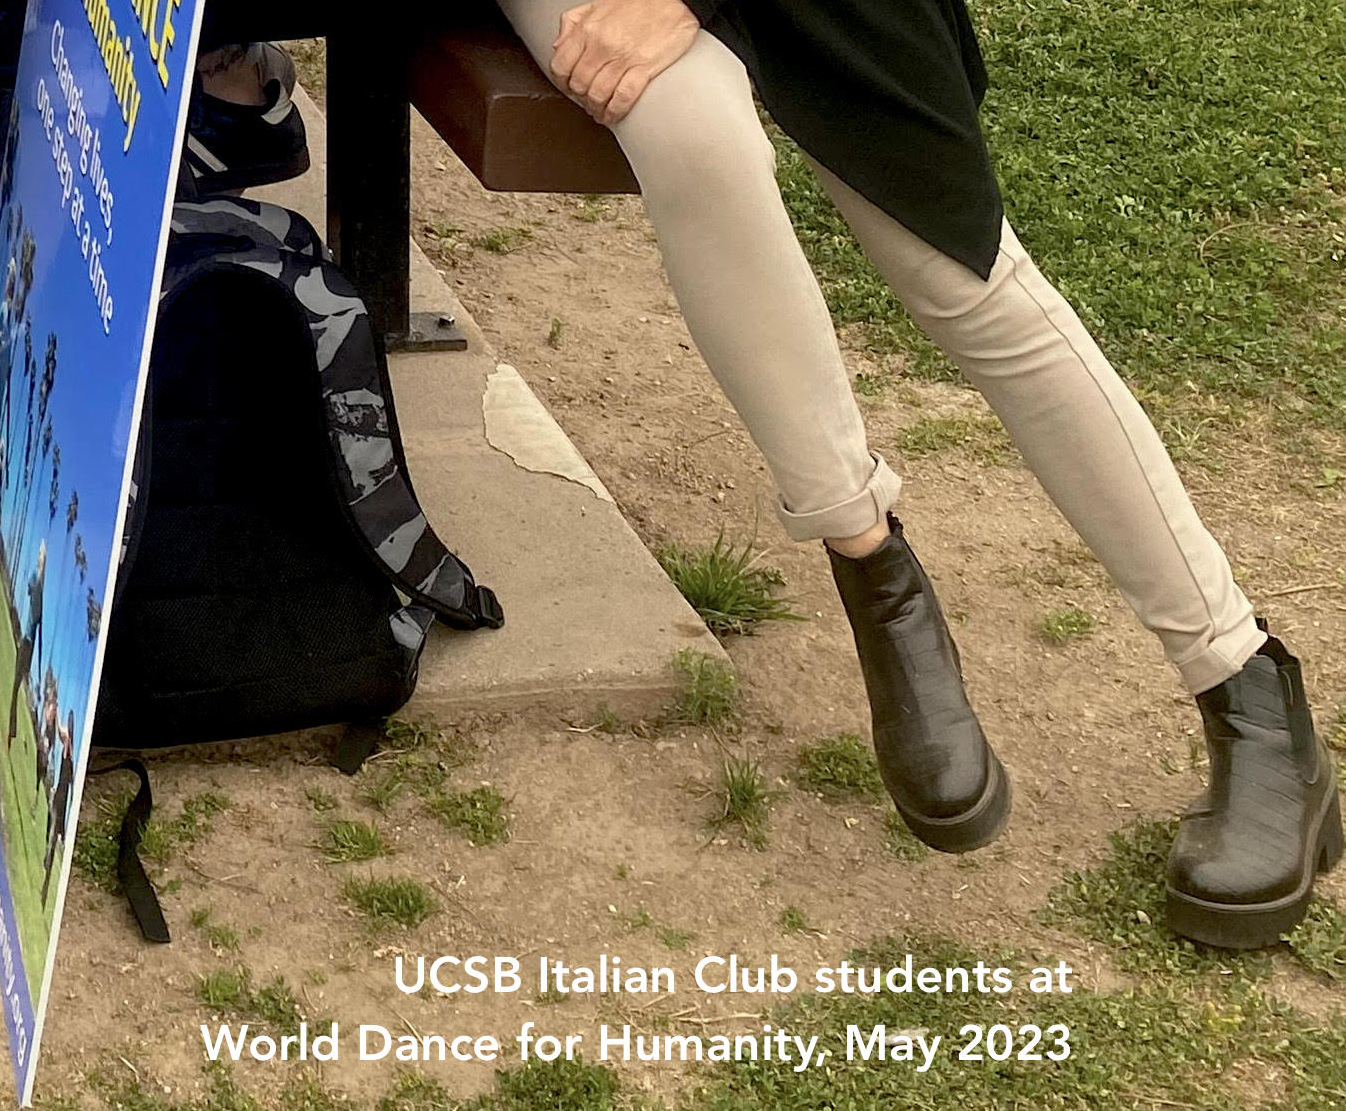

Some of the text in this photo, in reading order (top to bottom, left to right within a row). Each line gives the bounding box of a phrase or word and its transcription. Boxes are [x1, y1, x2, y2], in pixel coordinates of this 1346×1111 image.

[37, 78, 113, 335] one step at a time
[50, 20, 114, 246] Changing lives,
